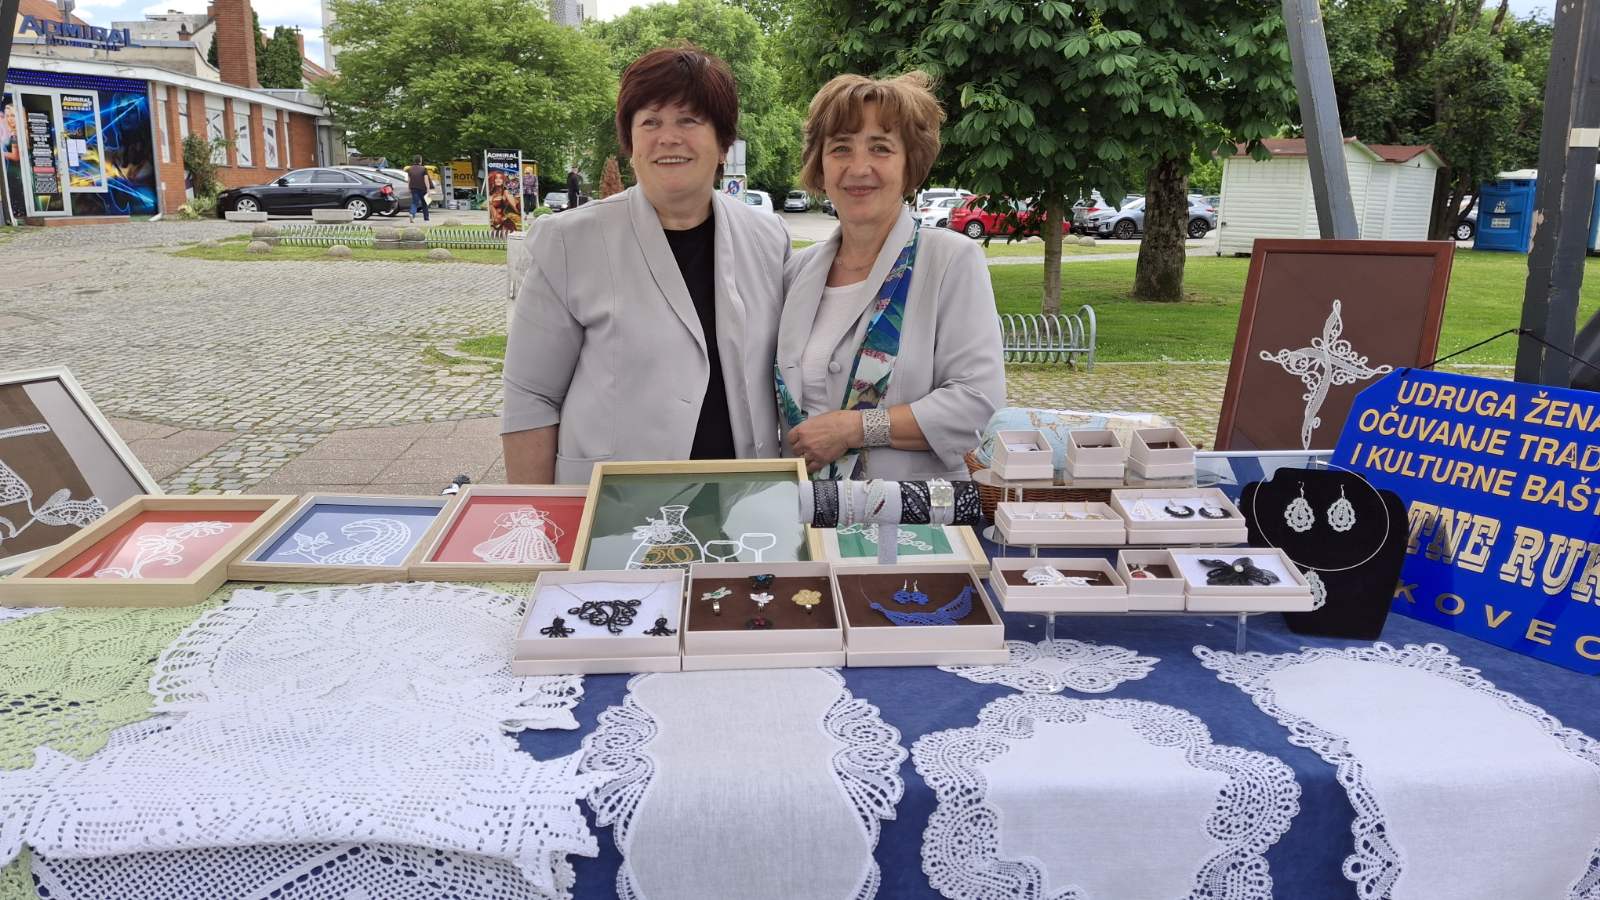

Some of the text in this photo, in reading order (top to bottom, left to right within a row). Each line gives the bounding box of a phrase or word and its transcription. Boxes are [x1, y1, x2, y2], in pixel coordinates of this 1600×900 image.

[18, 15, 131, 46] ADMIRAL
[1397, 380, 1600, 432] UDRUGA ŽENA
[1359, 405, 1600, 472] OČUVANJE TRAD
[1349, 442, 1363, 465] I
[1365, 445, 1517, 497] KULTURNE
